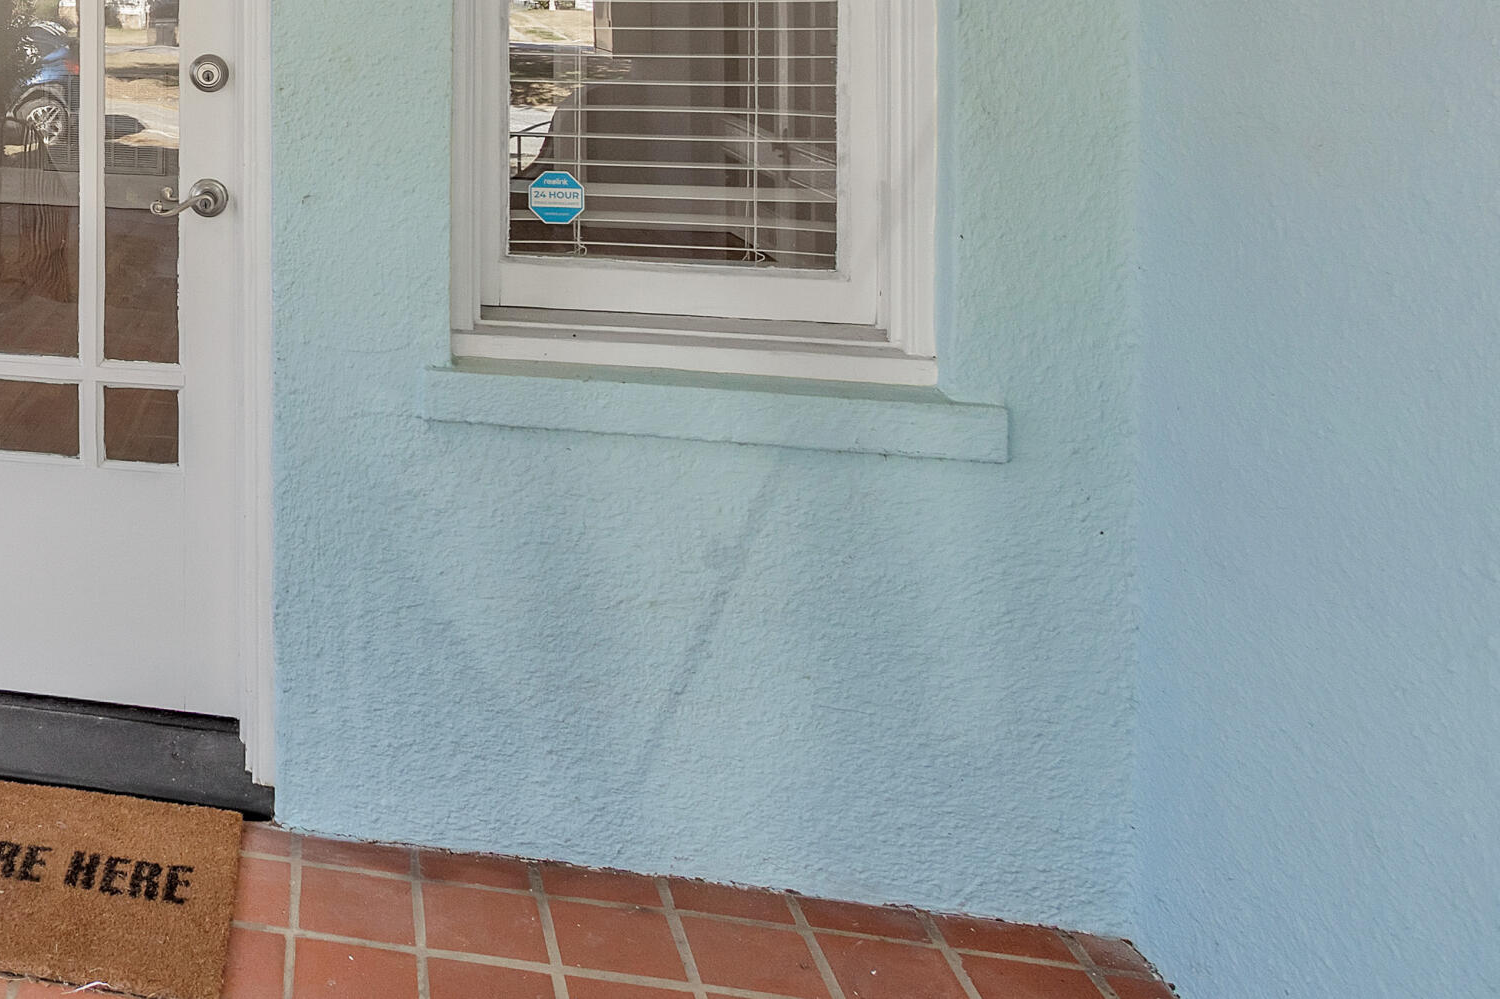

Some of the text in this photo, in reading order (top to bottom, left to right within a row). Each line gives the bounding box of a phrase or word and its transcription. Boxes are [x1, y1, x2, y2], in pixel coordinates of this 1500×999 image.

[533, 190, 580, 200] 24 HOUR
[63, 850, 195, 905] HERE
